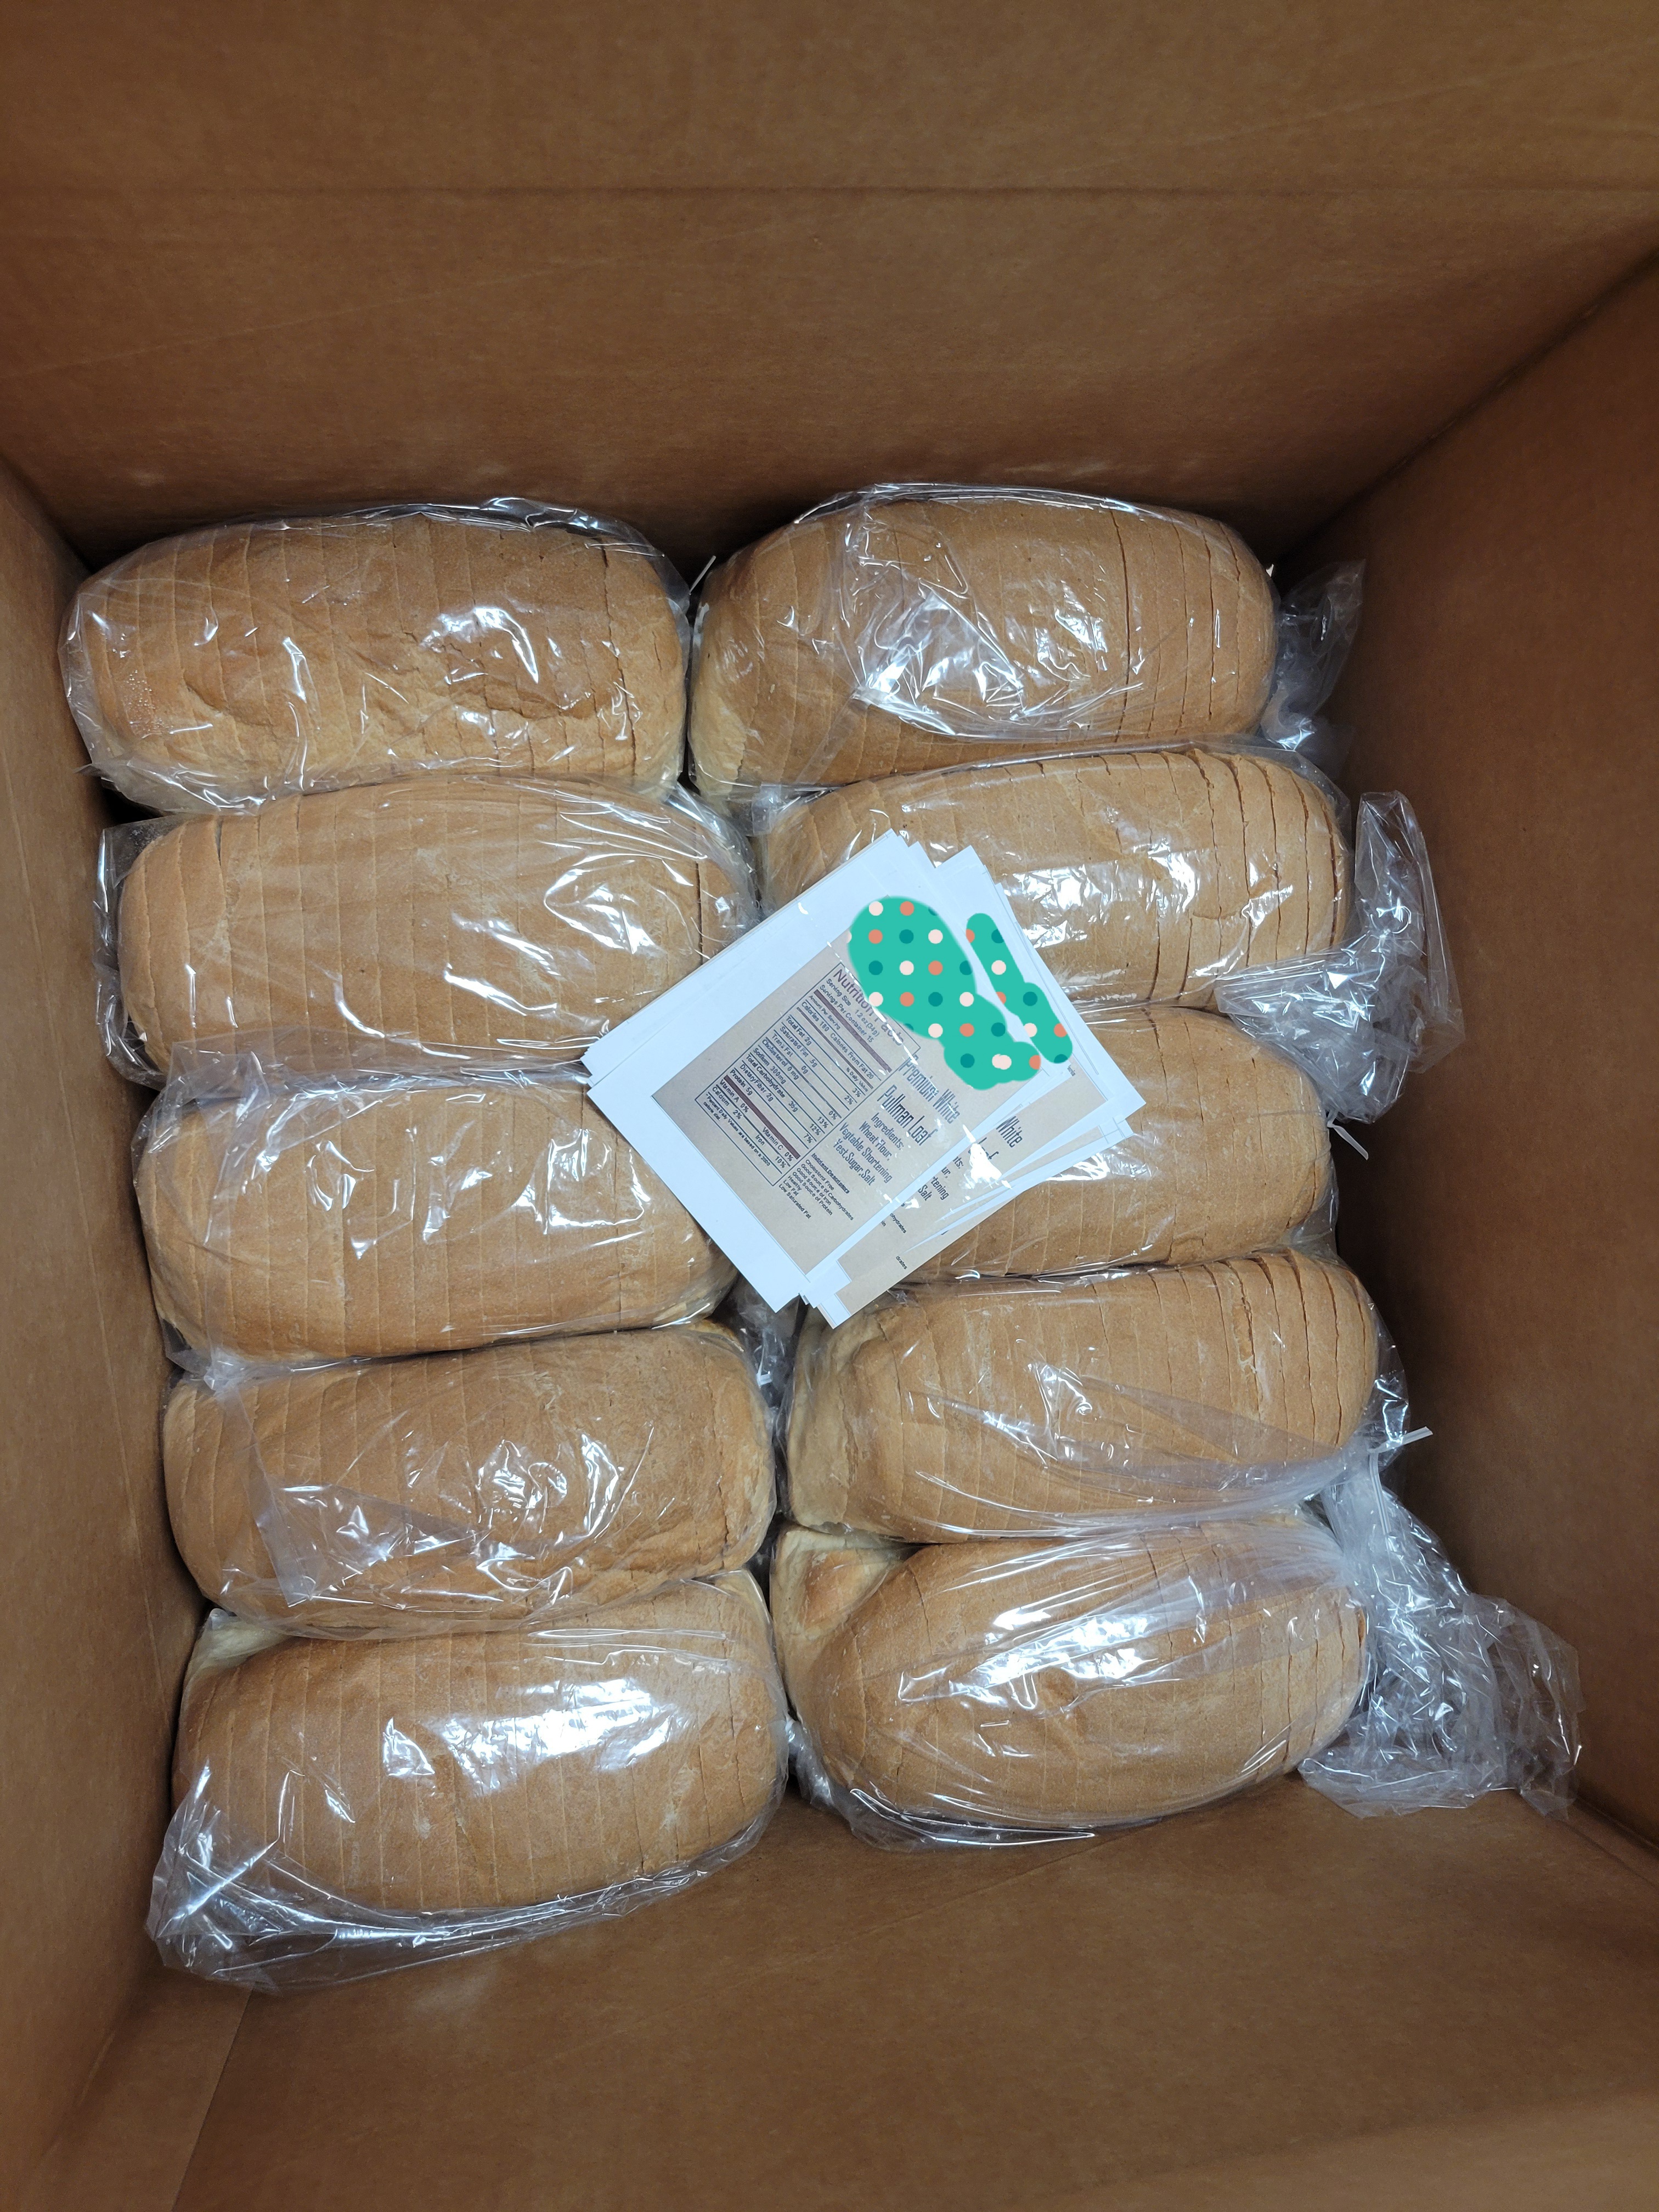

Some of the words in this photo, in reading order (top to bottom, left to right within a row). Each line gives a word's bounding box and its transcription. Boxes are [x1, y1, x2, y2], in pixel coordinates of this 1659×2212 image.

[808, 994, 823, 1010] Amount
[820, 1007, 829, 1016] Per
[826, 1014, 842, 1031] Serving
[819, 983, 839, 1006] Servings
[836, 1002, 847, 1014] Per
[844, 1011, 868, 1036] Container
[866, 1034, 874, 1043] 15
[825, 977, 843, 998] Serving
[840, 994, 852, 1007] Size
[832, 968, 879, 1017] Nutrition
[771, 1032, 786, 1049] Trans
[782, 1046, 794, 1058] Fat
[800, 1064, 809, 1075] 0g
[785, 1015, 799, 1030] Total
[795, 1027, 806, 1038] Fat
[803, 1036, 812, 1047] 2g
[851, 1087, 862, 1098] 3%
[800, 1001, 820, 1022] Calories
[829, 1031, 849, 1054] Calories
[847, 1051, 861, 1066] From
[857, 1063, 868, 1074] Fat
[865, 1070, 874, 1080] 20
[729, 1068, 747, 1088] Protein
[744, 1086, 754, 1097] 5g
[752, 1046, 770, 1066] Sodium
[769, 1065, 787, 1085] 300mg
[816, 1115, 830, 1129] 13%
[760, 1038, 789, 1068] Cholesterol
[789, 1069, 800, 1081] mg
[827, 1109, 838, 1121] 0%
[778, 1025, 803, 1050] Saturated
[799, 1047, 809, 1058] Fat
[843, 1094, 854, 1105] 2%
[848, 1070, 860, 1082] Daily
[744, 1053, 759, 1068] Total
[755, 1065, 786, 1099] Carbohydrate
[808, 1122, 822, 1136] 12%
[897, 1053, 940, 1103] Premium
[931, 1087, 961, 1125] White
[711, 1085, 731, 1107] Calcium
[731, 1109, 743, 1120] 2%
[754, 1133, 766, 1146] Iron
[774, 1155, 787, 1169] 10%
[718, 1078, 735, 1098] Vitamin
[732, 1095, 740, 1103] A
[739, 1102, 750, 1114] 0%
[761, 1126, 779, 1147] Vitamin
[783, 1150, 794, 1163] 0%
[765, 1092, 775, 1103] 2g
[802, 1132, 814, 1144] 7%
[857, 1120, 879, 1144] Wheat
[870, 1111, 905, 1151] Ingredients:
[876, 1083, 915, 1129] Pullman
[906, 1114, 939, 1147] Loaf
[742, 1136, 755, 1150] based
[838, 1121, 865, 1152] Vegtable
[860, 1146, 893, 1184] Shortening
[782, 1178, 793, 1189] Low
[790, 1187, 799, 1197] Fat
[786, 1175, 803, 1192] Healthy
[791, 1170, 804, 1184] Good
[801, 1181, 816, 1198] Source
[818, 1199, 833, 1216] Protein
[795, 1166, 808, 1180] Good
[805, 1177, 821, 1194] Source
[822, 1195, 832, 1206] Iron
[800, 1163, 812, 1176] Good
[809, 1173, 825, 1189] Source
[826, 1192, 854, 1221] Carbohydrates
[804, 1158, 827, 1182] Cholesterol
[824, 1180, 835, 1192] Free
[810, 1152, 830, 1172] Nutrient
[826, 1169, 850, 1195] Descriptors
[777, 1183, 788, 1193] Low
[785, 1191, 805, 1212] Saturated
[803, 1209, 812, 1219] Fat
